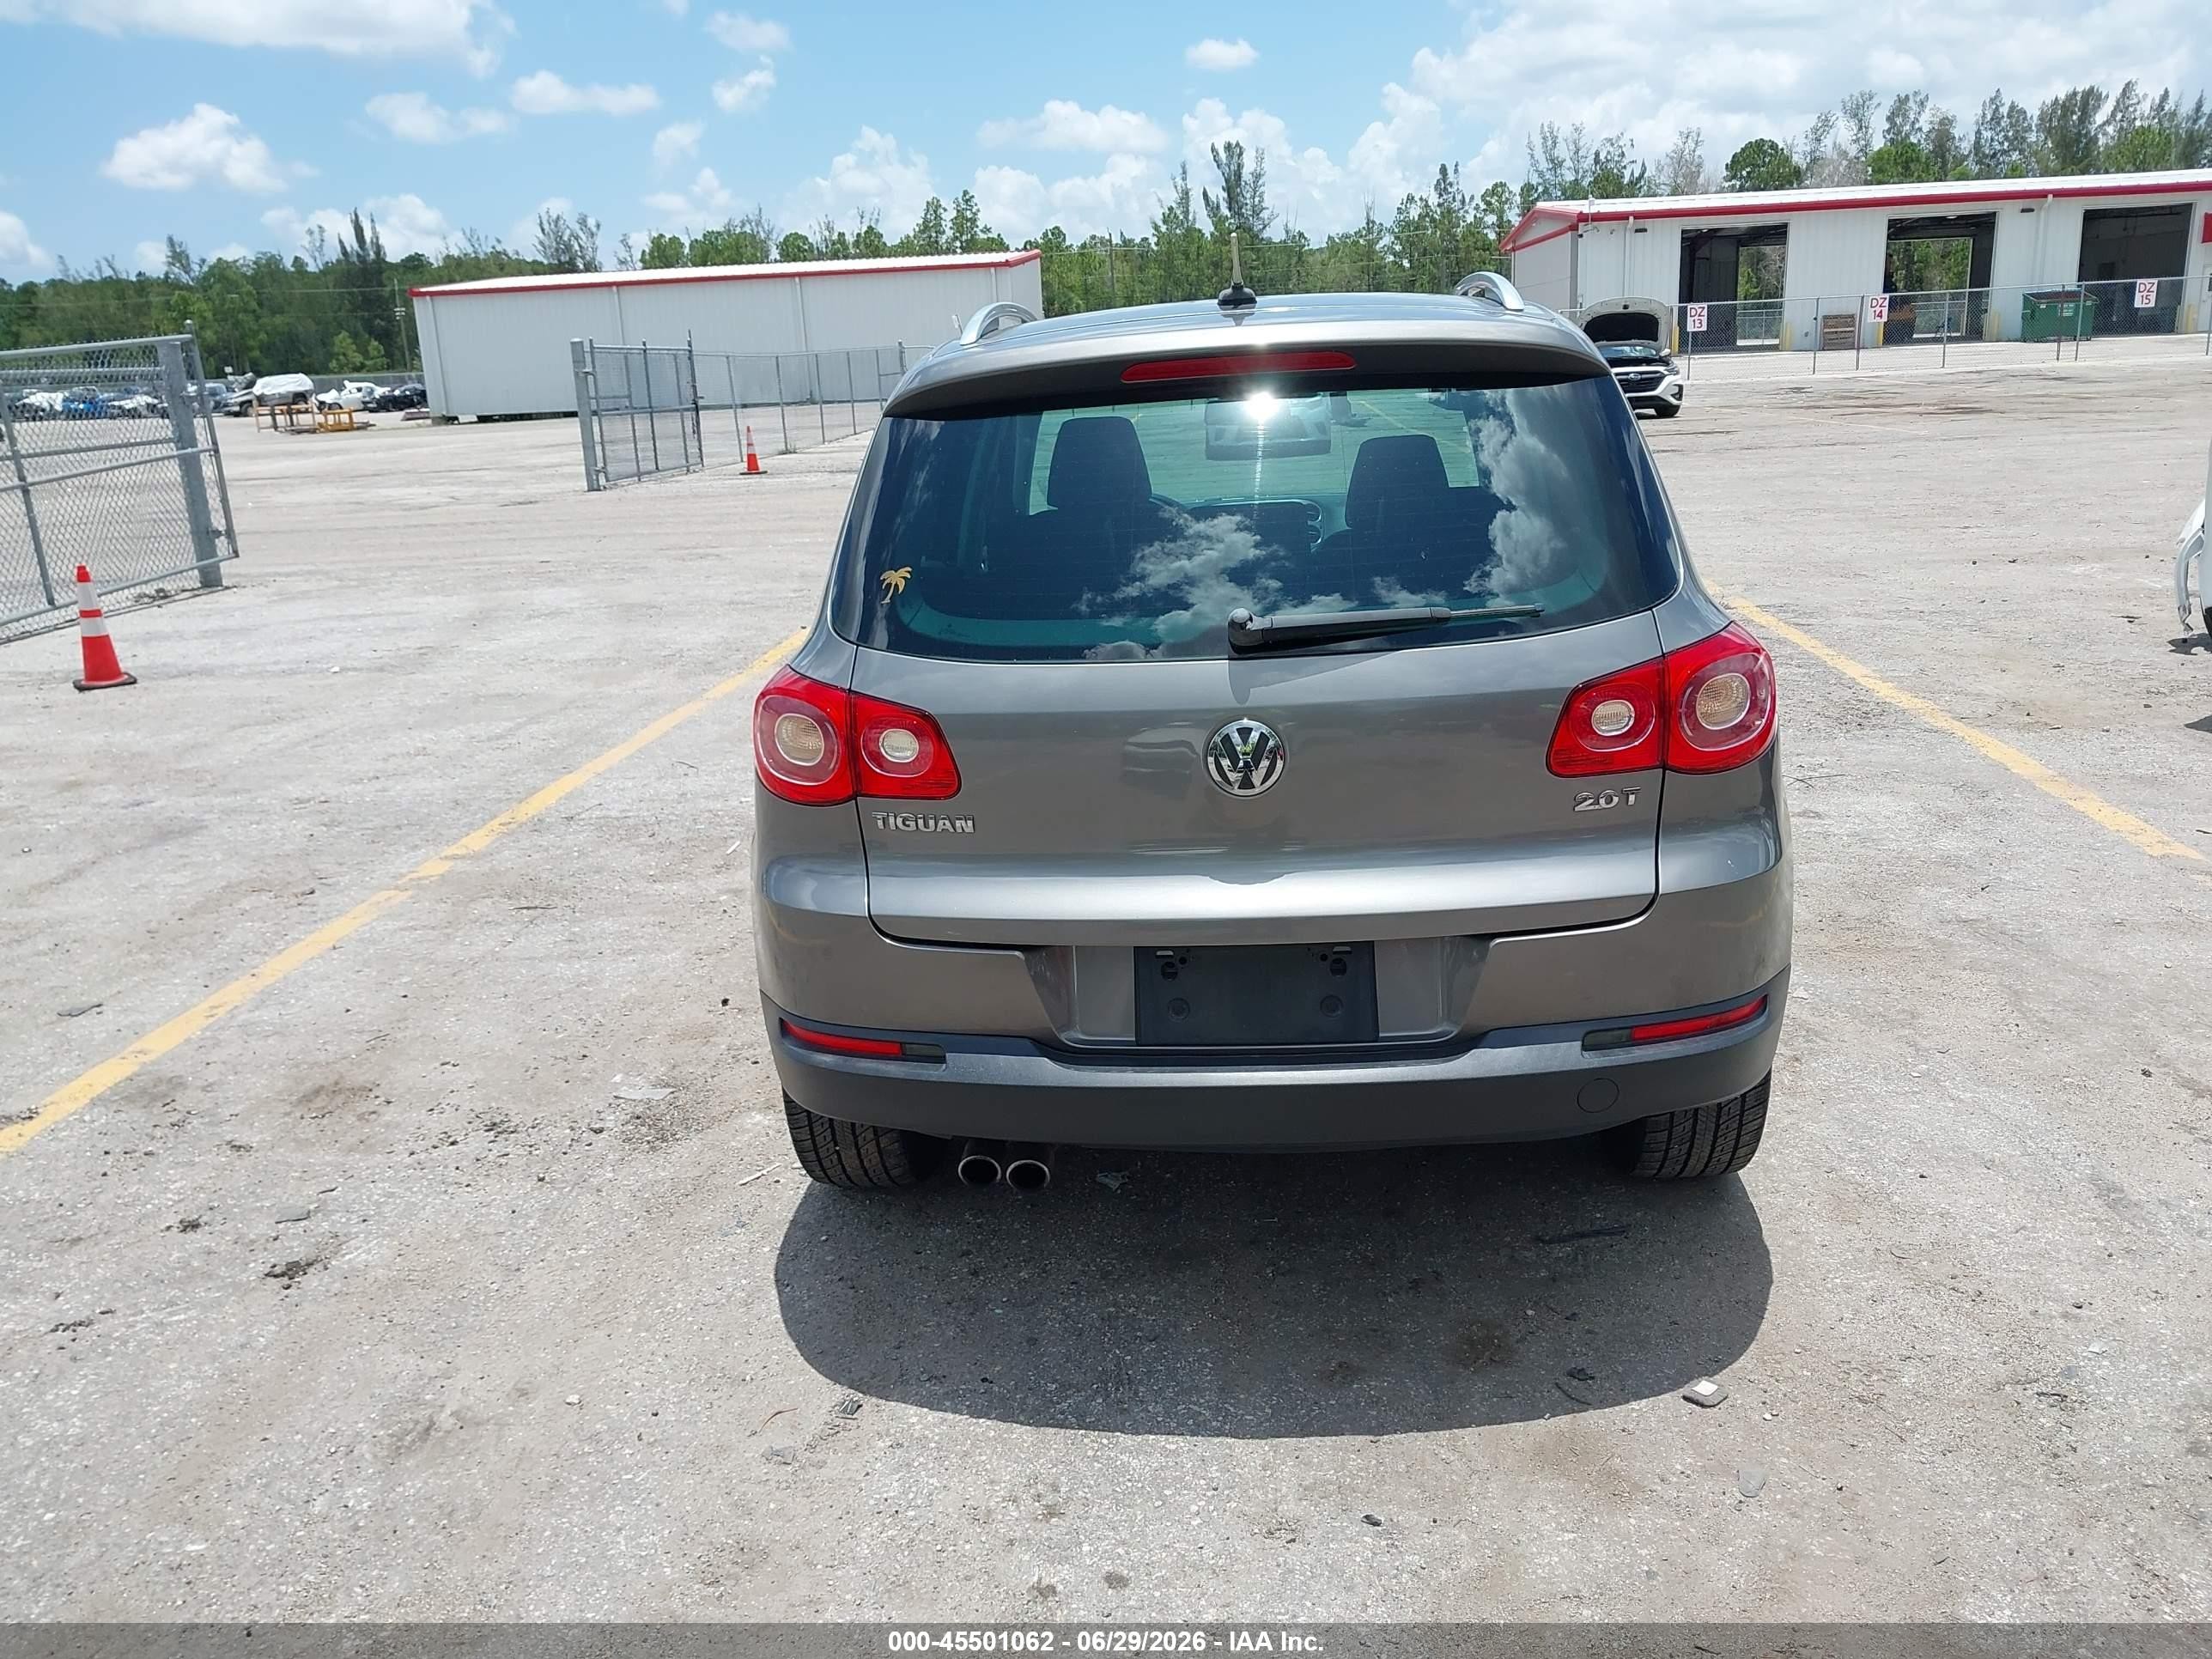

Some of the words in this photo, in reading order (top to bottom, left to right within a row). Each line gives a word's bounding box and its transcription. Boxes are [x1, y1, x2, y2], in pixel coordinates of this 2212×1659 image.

[2138, 282, 2155, 293] DZ
[1870, 297, 1887, 308] DZ
[2141, 294, 2151, 305] 15
[1689, 307, 1705, 318] DZ
[1874, 309, 1883, 319] 14
[1692, 319, 1703, 329] 13
[872, 811, 975, 833] TIGUAN
